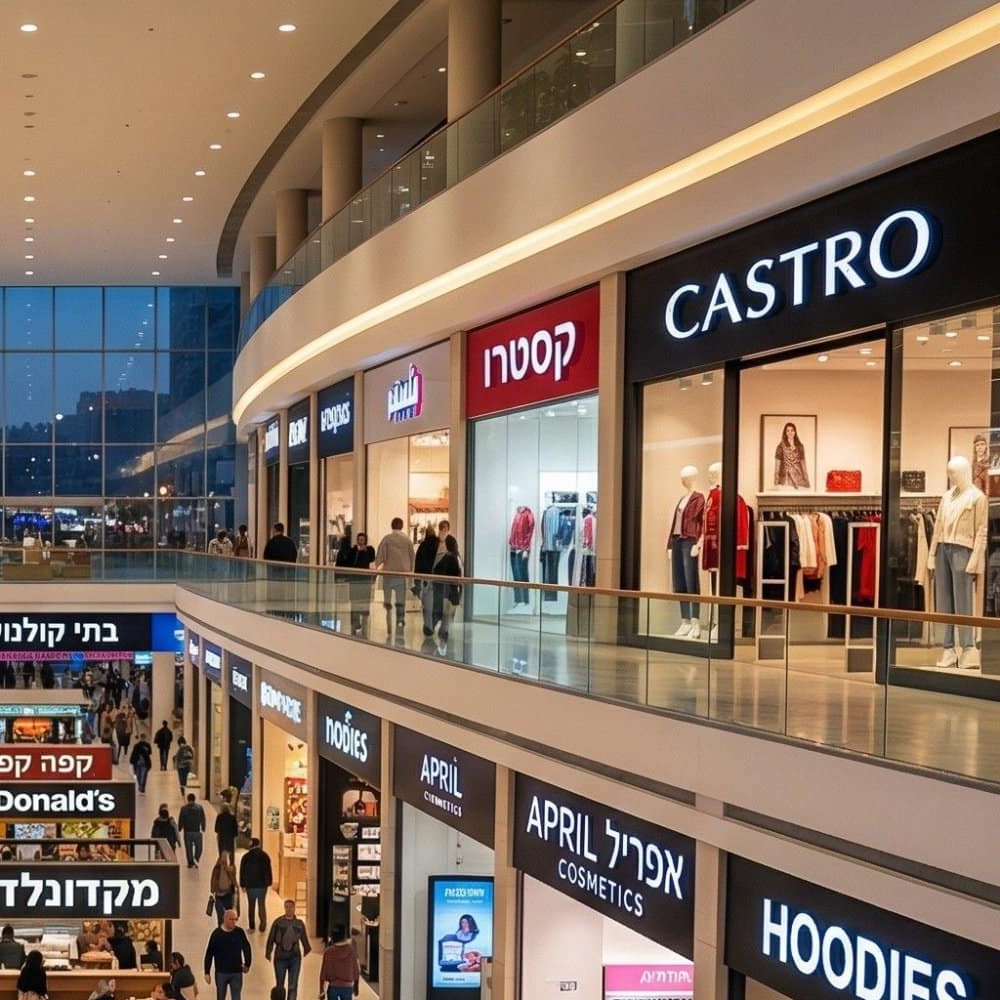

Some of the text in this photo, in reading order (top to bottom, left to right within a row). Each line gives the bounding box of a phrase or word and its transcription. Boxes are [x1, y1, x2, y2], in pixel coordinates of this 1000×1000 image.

[665, 210, 931, 339] CASTRO
[484, 321, 576, 388] קסטרו
[74, 622, 119, 642] בתי
[40, 754, 93, 778] קפה
[420, 754, 463, 799] APRIL
[526, 795, 598, 863] APRIL
[604, 818, 684, 900] אפריל
[558, 858, 643, 917] COSMETICS
